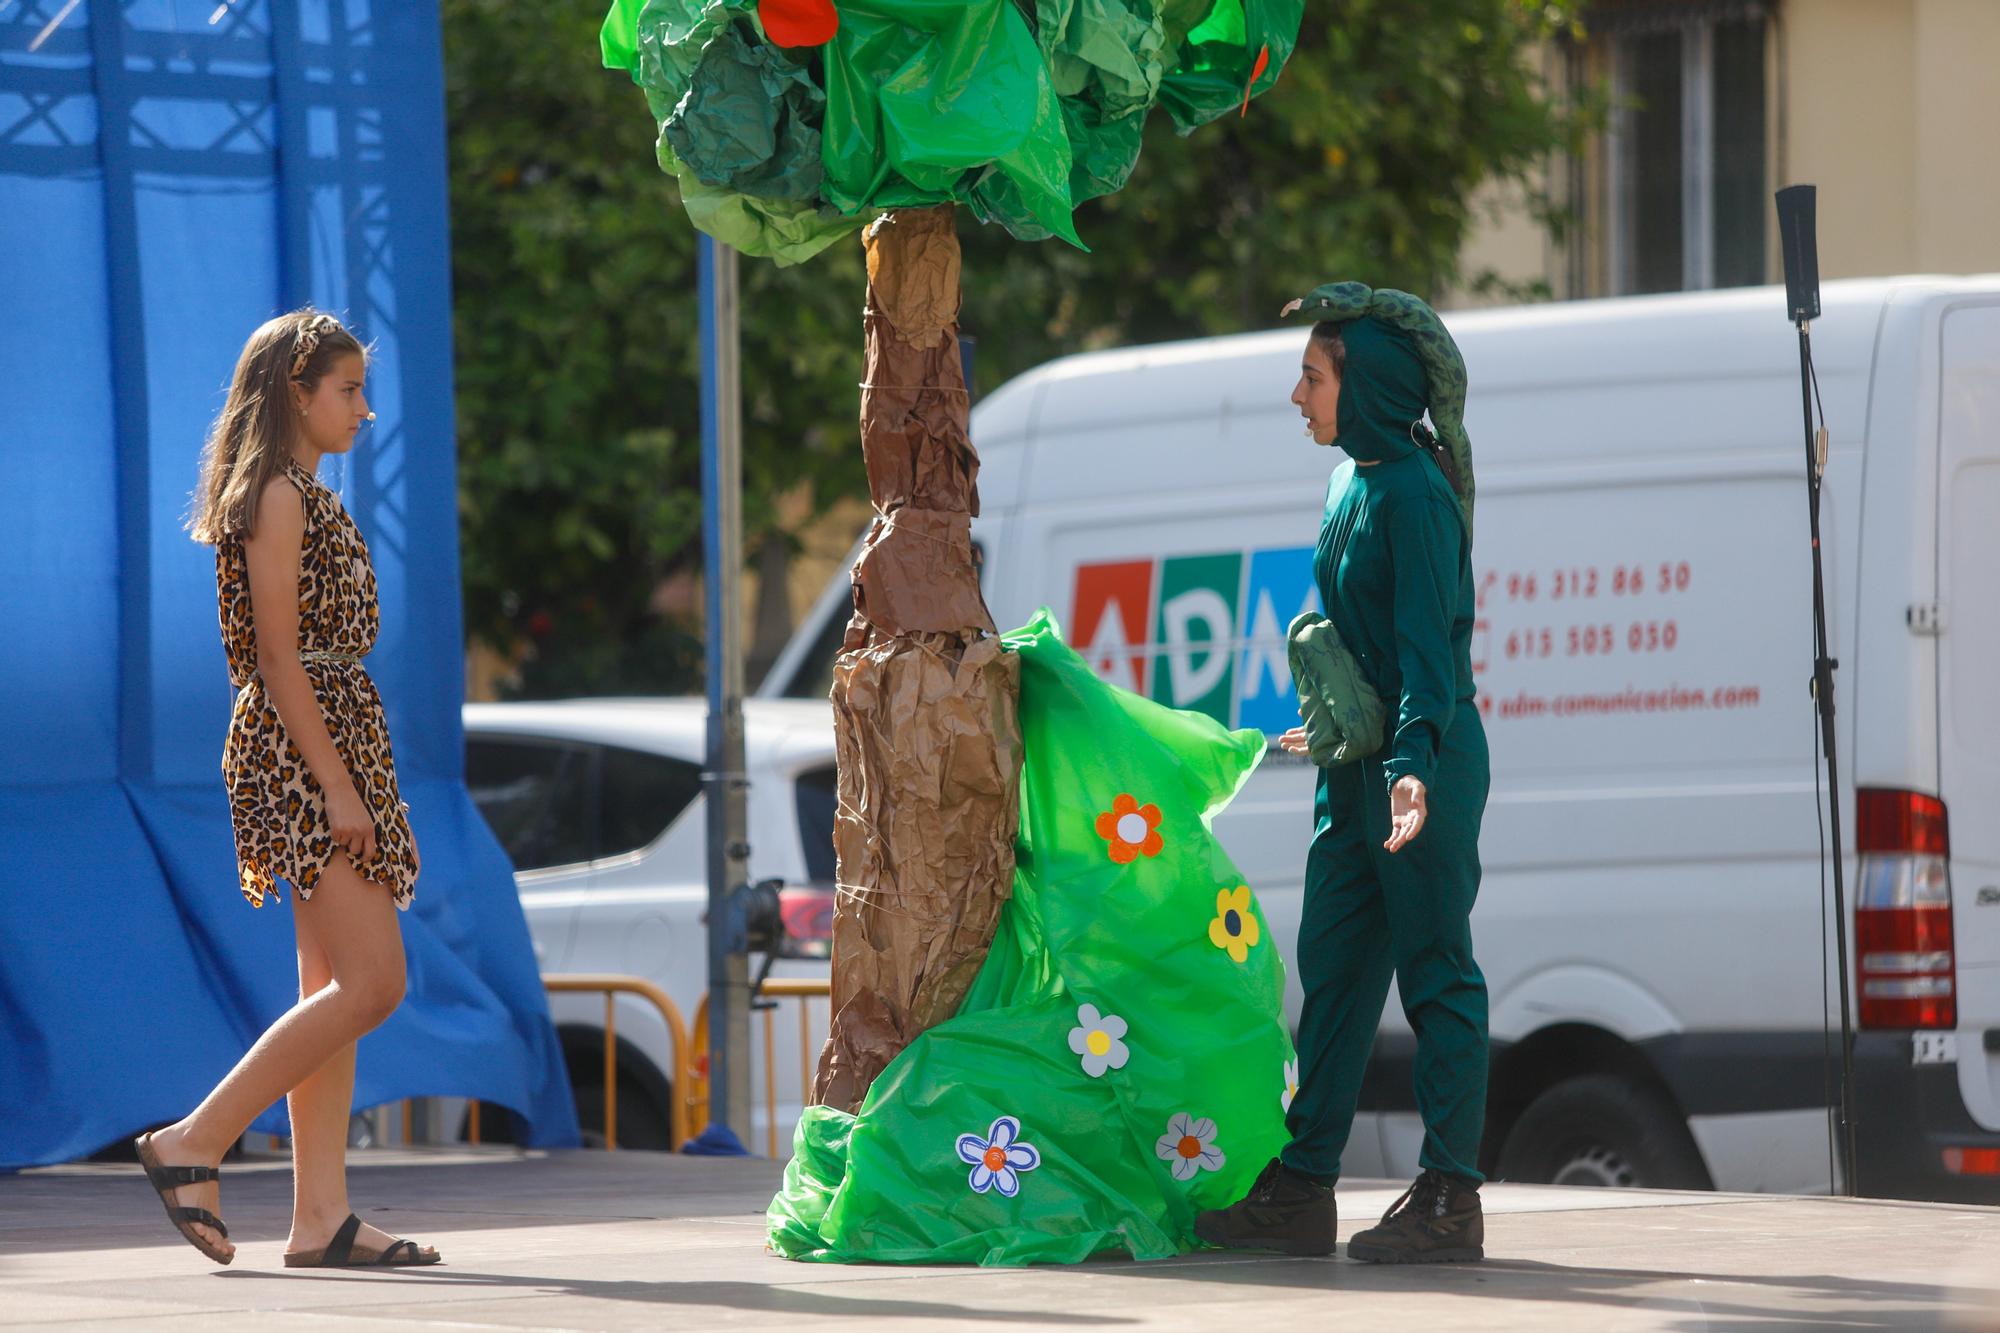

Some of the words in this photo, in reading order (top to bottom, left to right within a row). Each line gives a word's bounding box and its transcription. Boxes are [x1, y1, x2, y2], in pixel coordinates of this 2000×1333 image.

[1506, 571, 1538, 602] 96
[1552, 567, 1598, 600] 312
[1612, 564, 1645, 596] 86
[1657, 560, 1692, 594] 50
[1505, 630, 1552, 660] 615
[1566, 624, 1613, 656] 505
[1628, 619, 1677, 652] 050
